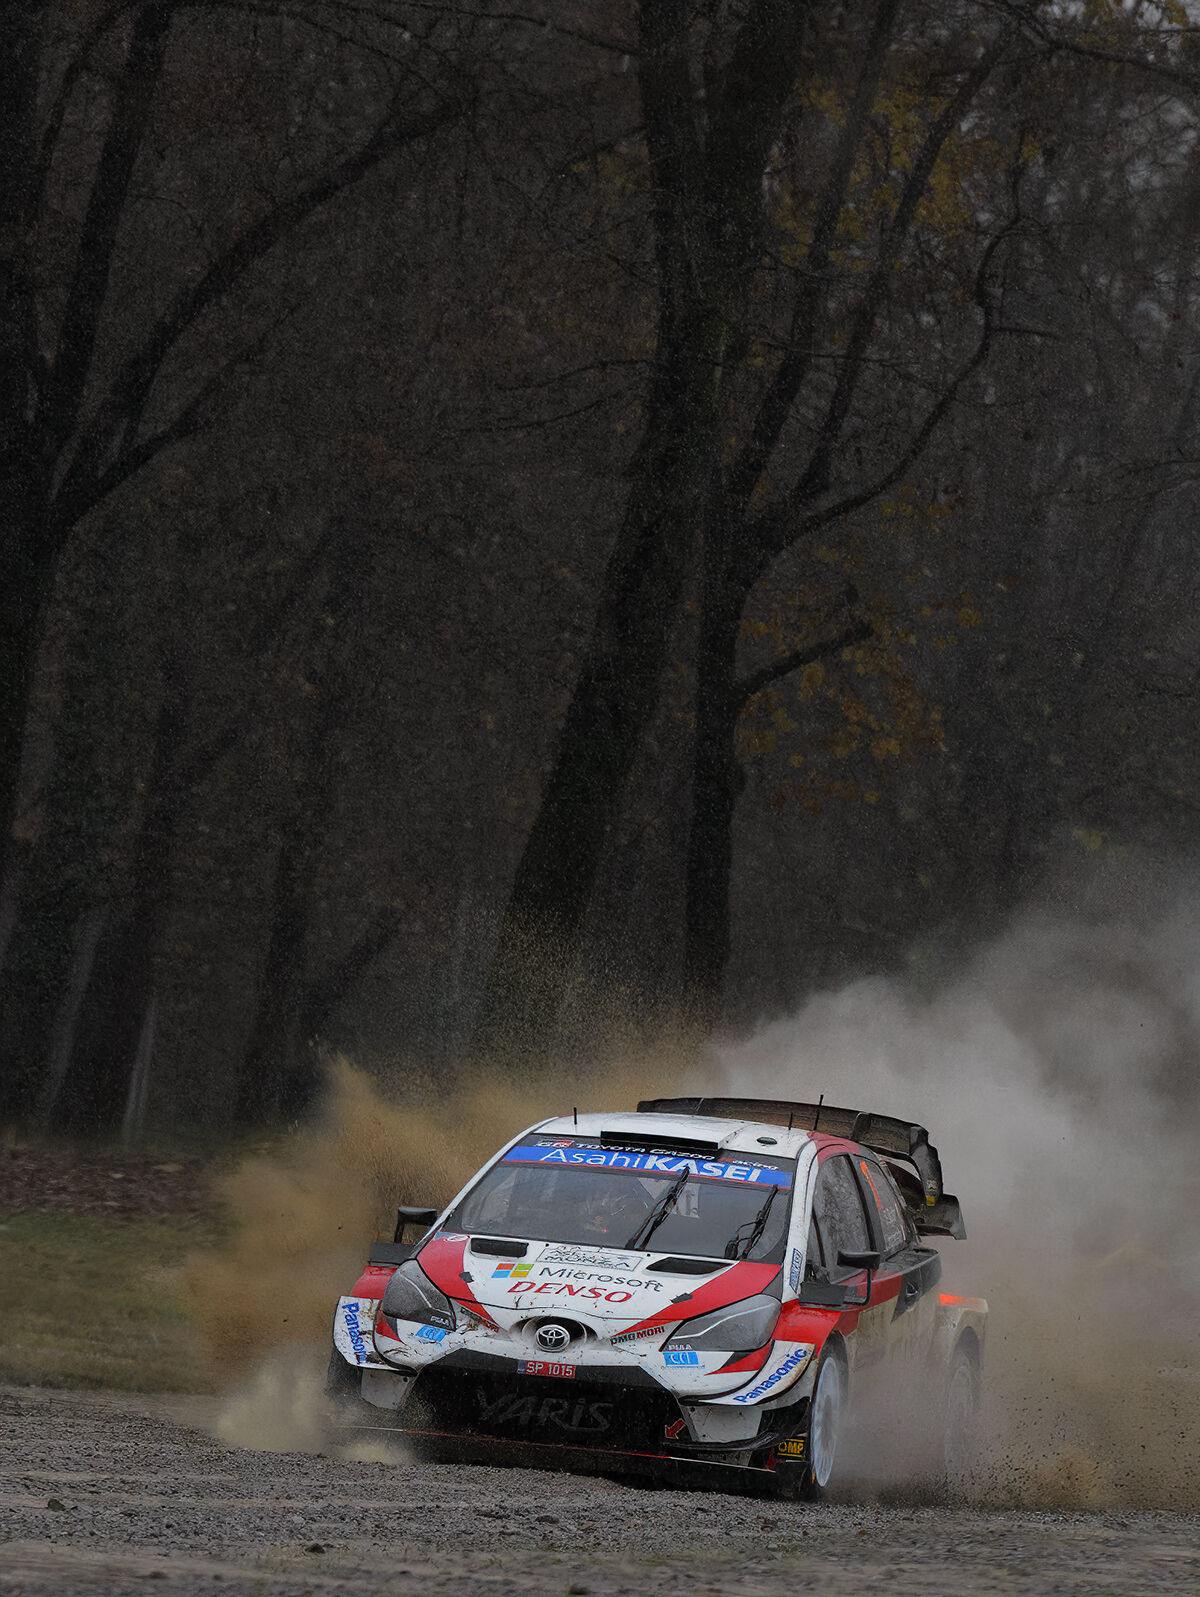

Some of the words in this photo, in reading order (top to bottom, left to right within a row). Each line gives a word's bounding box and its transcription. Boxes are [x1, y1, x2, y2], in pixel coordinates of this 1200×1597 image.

[576, 1143, 645, 1152] TOYOTA
[649, 1149, 715, 1160] GAZOO
[539, 1267, 663, 1293] Microsoft
[507, 1281, 633, 1303] DENSO
[526, 1361, 544, 1374] SP
[548, 1363, 573, 1377] 1015
[733, 1348, 808, 1403] Panasonic
[778, 1441, 804, 1454] OMP
